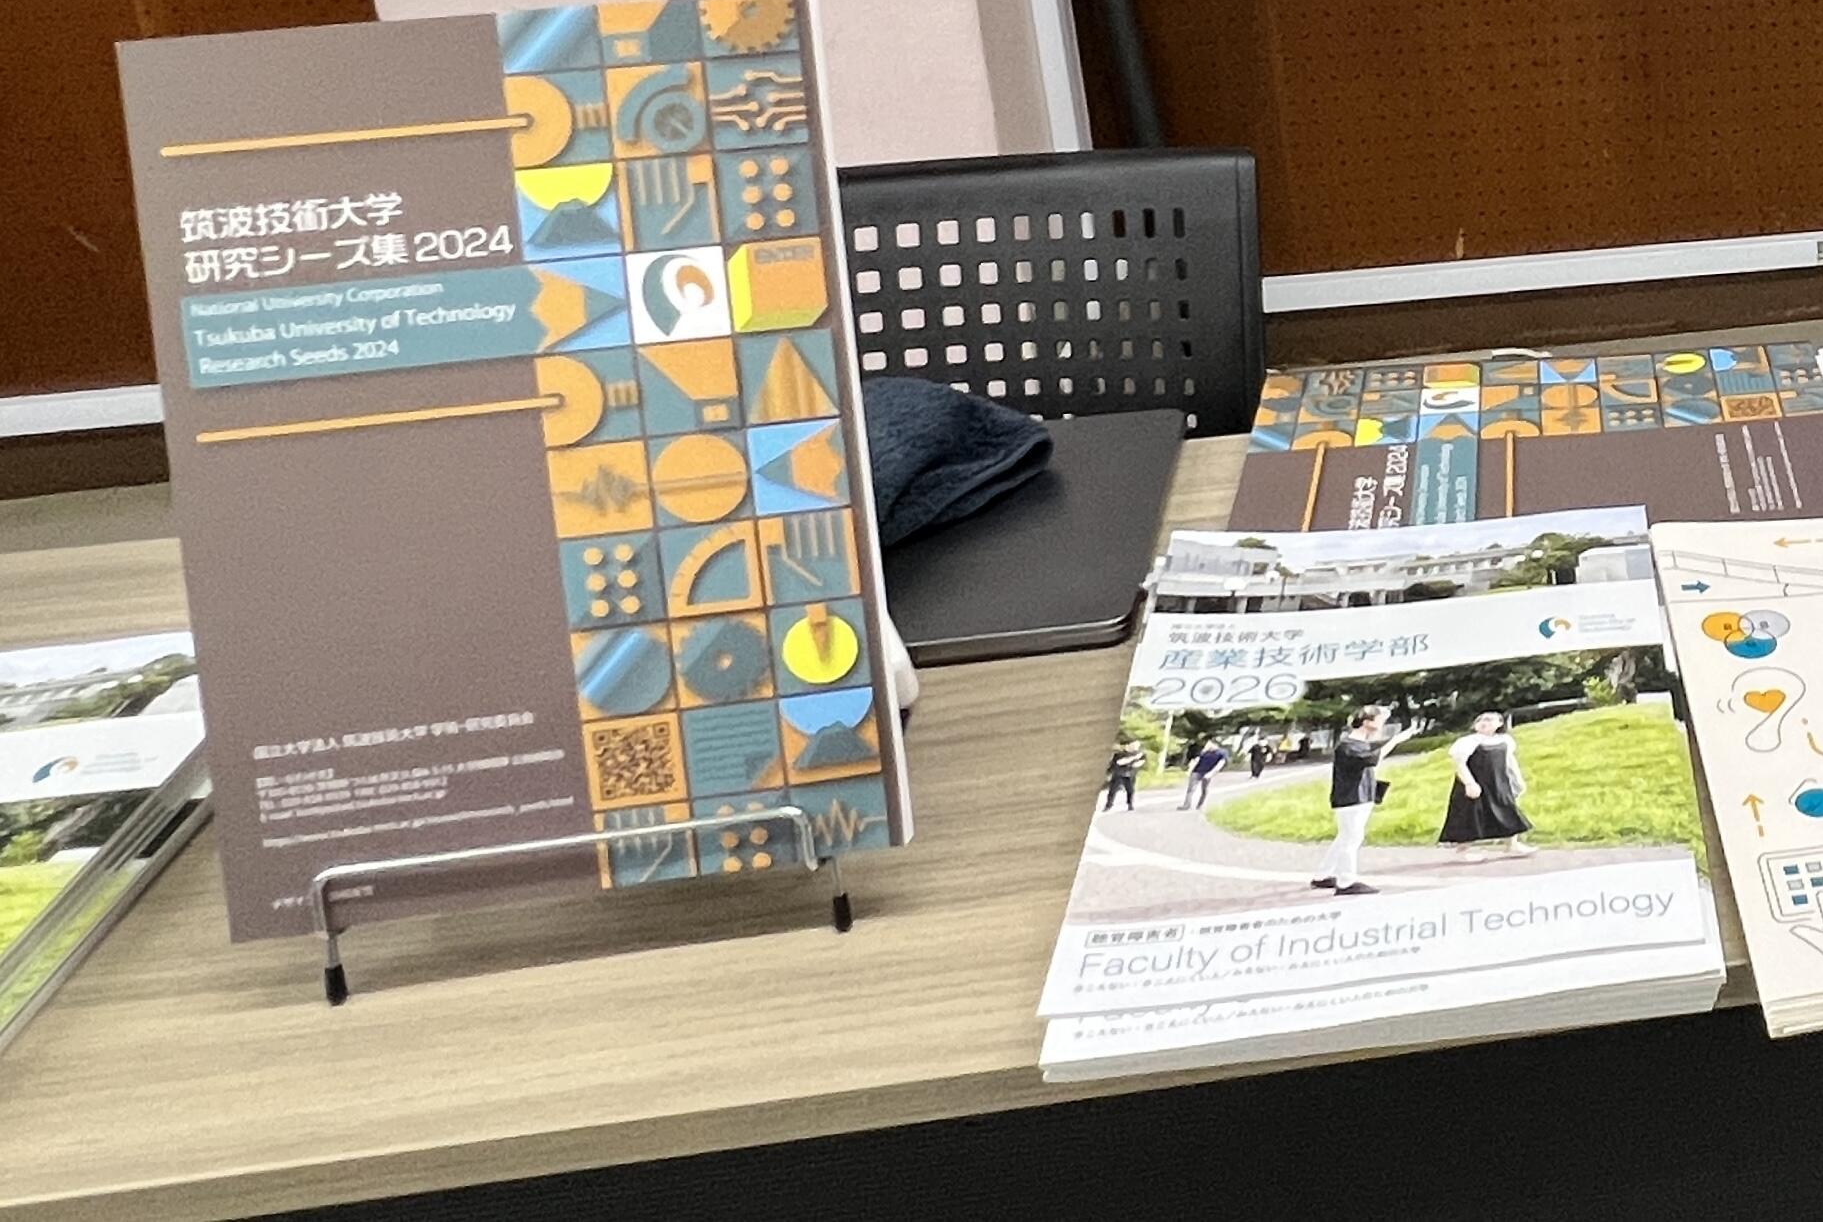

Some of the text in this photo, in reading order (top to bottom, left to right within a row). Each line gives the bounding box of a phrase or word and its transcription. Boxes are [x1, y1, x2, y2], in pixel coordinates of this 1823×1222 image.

[180, 190, 403, 245] 筑波技術大学
[191, 278, 443, 319] National University Corporation
[195, 299, 516, 347] Tsukuba University of Technology
[200, 338, 400, 375] Research Seeds 2024
[1158, 634, 1431, 671] 産業技術学部
[1167, 627, 1305, 647] 筑波技術大学
[1147, 673, 1299, 706] 2026
[1076, 890, 1675, 983] Faculty of Industrial Technology
